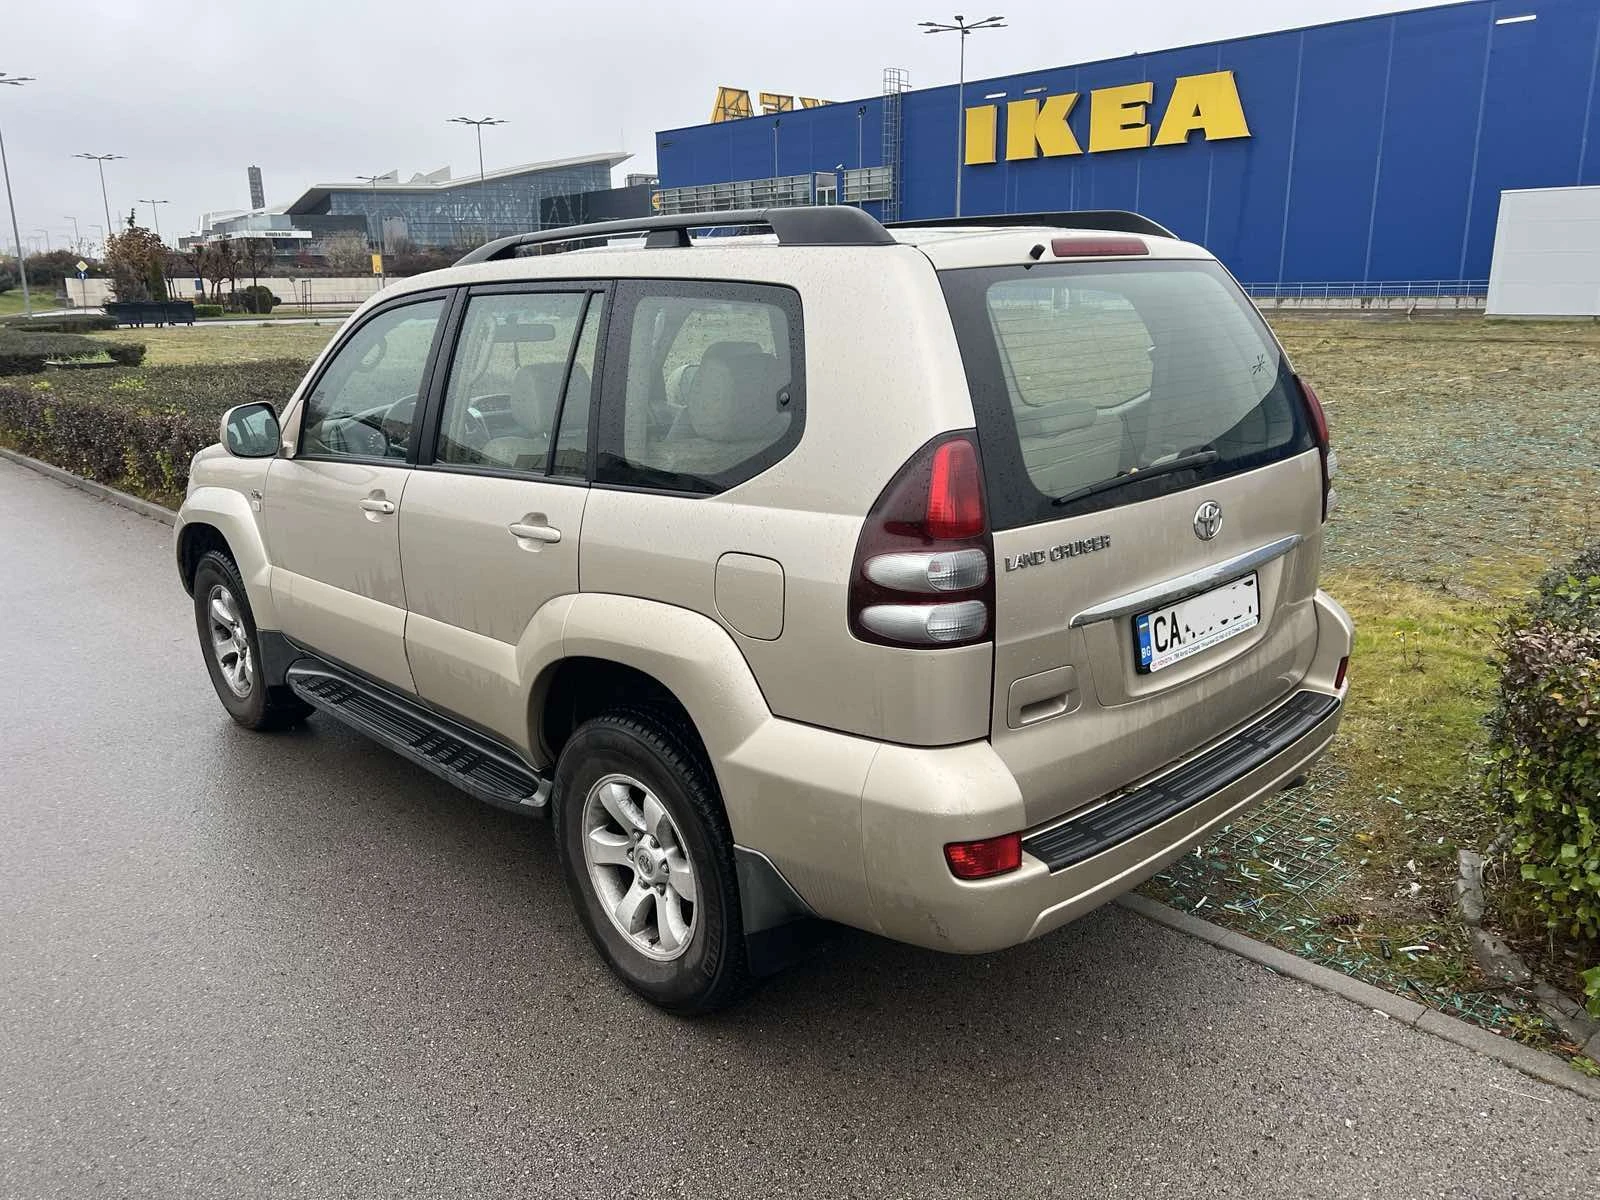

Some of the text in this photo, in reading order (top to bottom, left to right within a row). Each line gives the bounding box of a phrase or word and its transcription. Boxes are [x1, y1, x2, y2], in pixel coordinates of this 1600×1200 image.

[965, 70, 1251, 165] IKEA
[1004, 534, 1111, 572] LAND CRUISER
[1153, 611, 1182, 653] CA
[1141, 646, 1151, 659] BG
